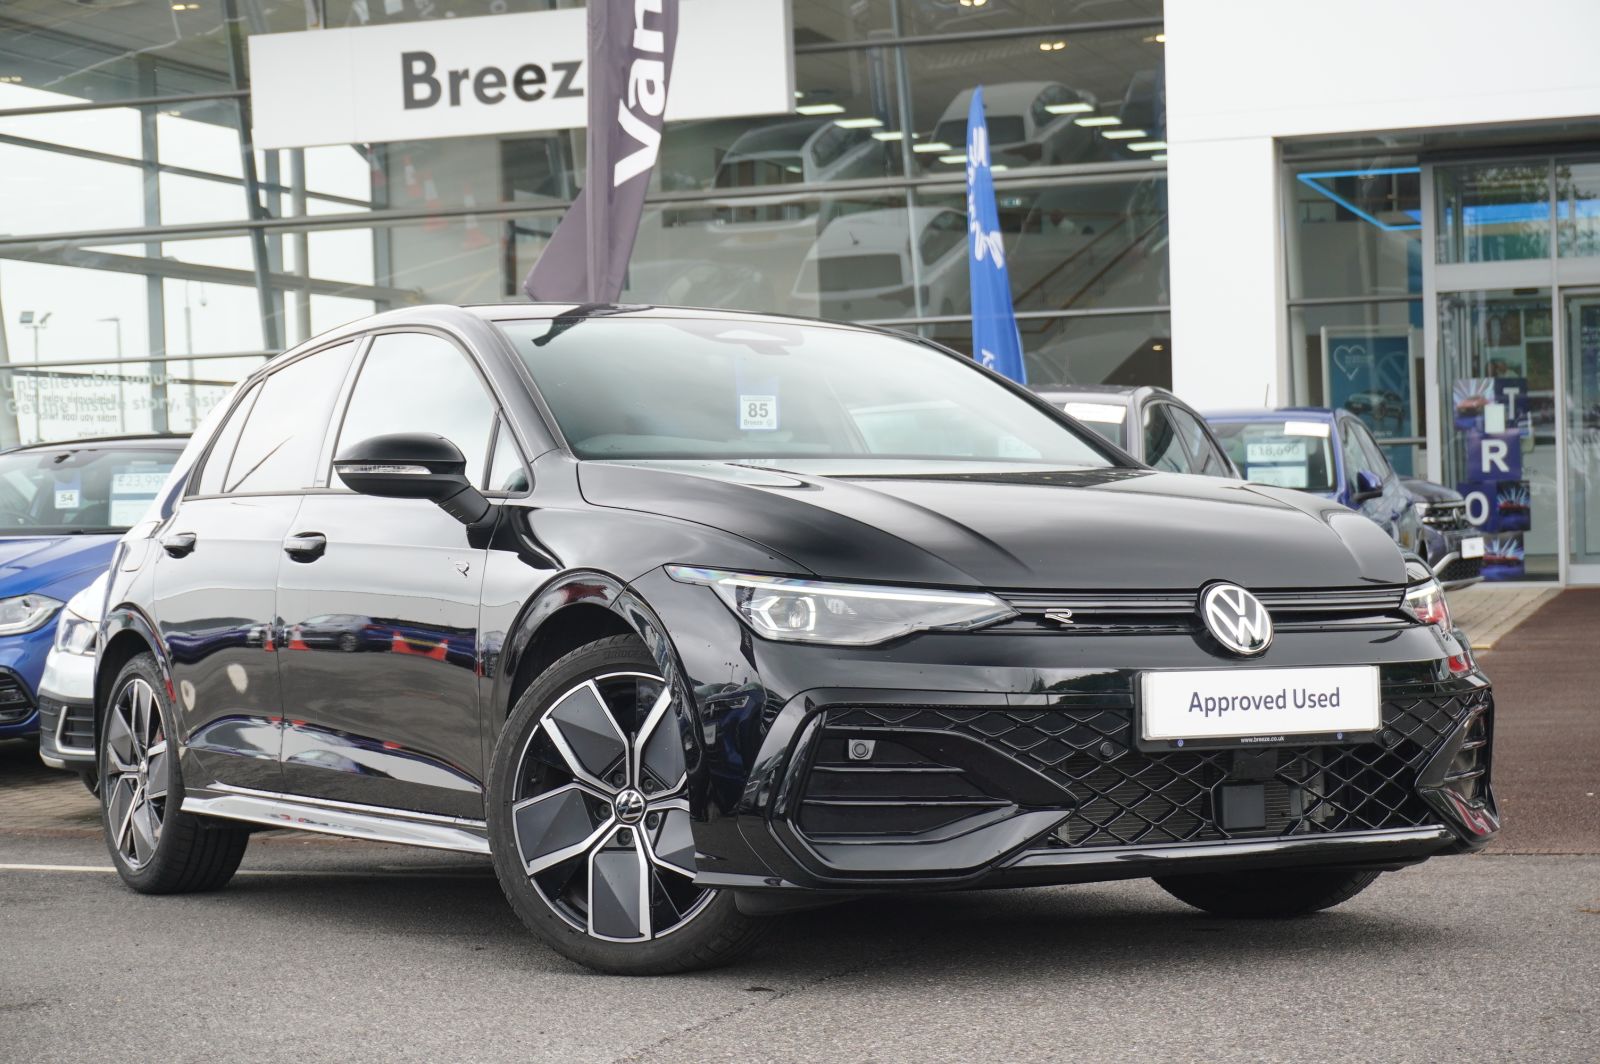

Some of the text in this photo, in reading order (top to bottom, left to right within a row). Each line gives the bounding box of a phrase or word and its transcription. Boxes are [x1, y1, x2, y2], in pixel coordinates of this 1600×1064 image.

[401, 51, 584, 110] Breez
[748, 403, 769, 418] 85
[61, 494, 74, 502] 54
[1188, 687, 1340, 717] Approved Used
